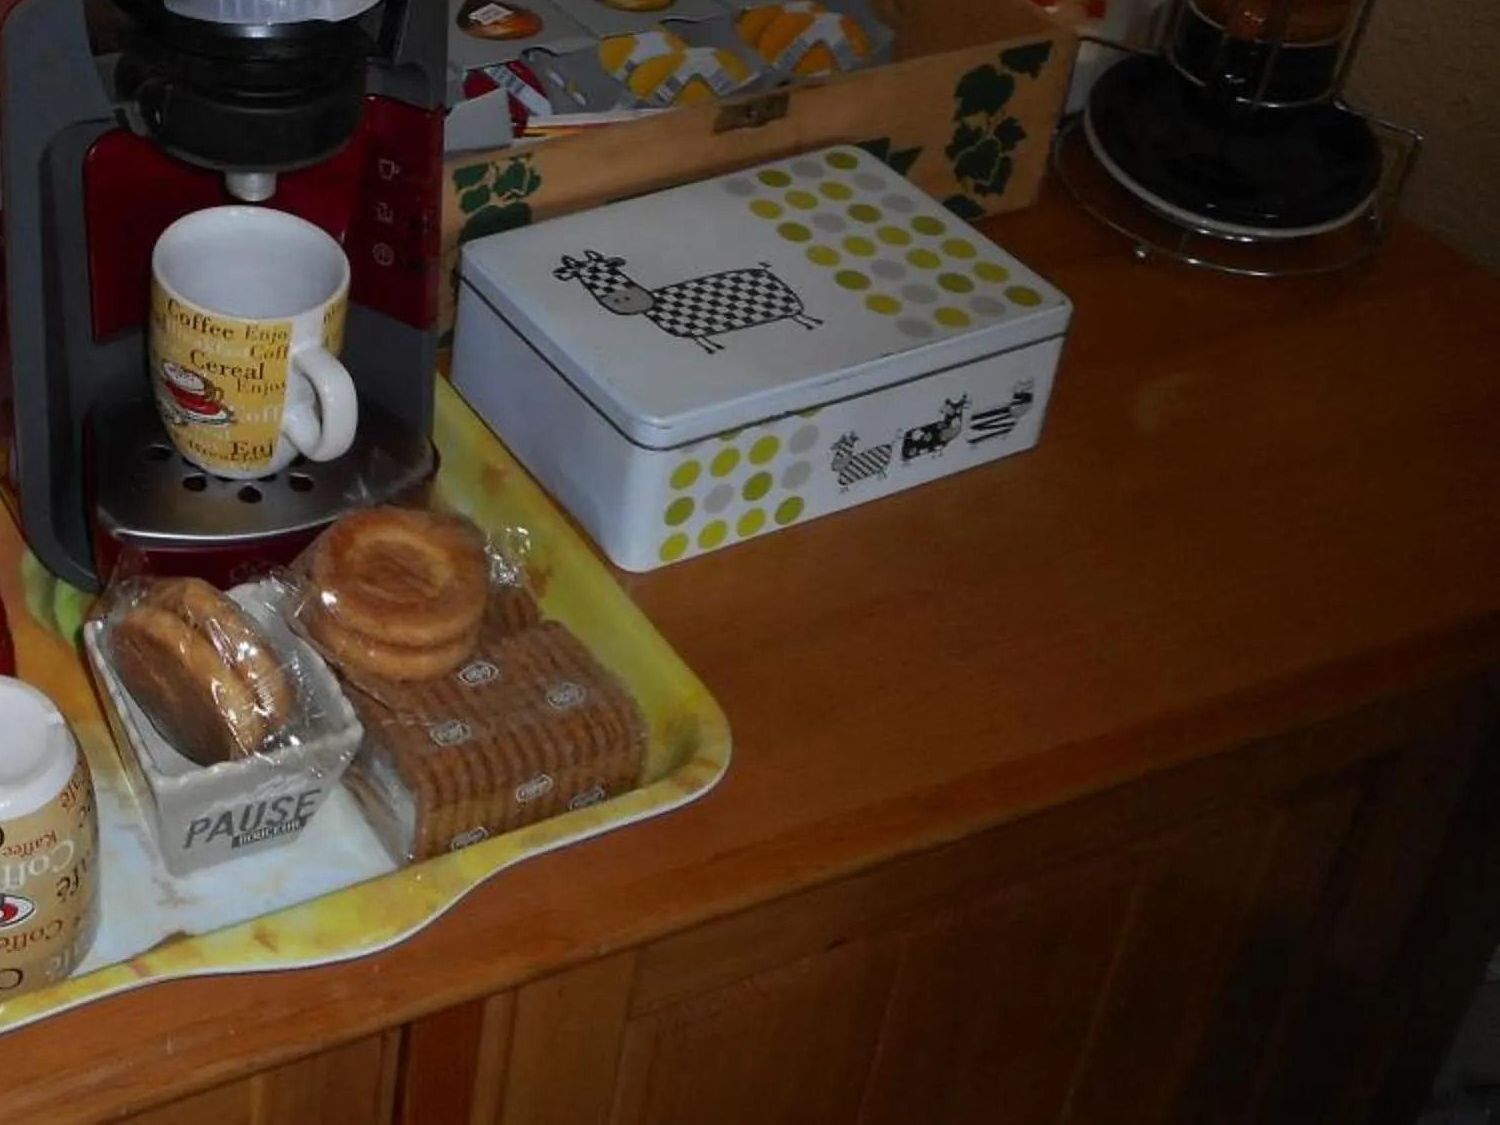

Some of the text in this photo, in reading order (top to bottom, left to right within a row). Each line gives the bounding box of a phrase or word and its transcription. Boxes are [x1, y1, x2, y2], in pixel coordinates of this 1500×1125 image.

[167, 298, 235, 341] Coffee
[190, 348, 265, 381] Cereal
[182, 787, 322, 850] PAUSE
